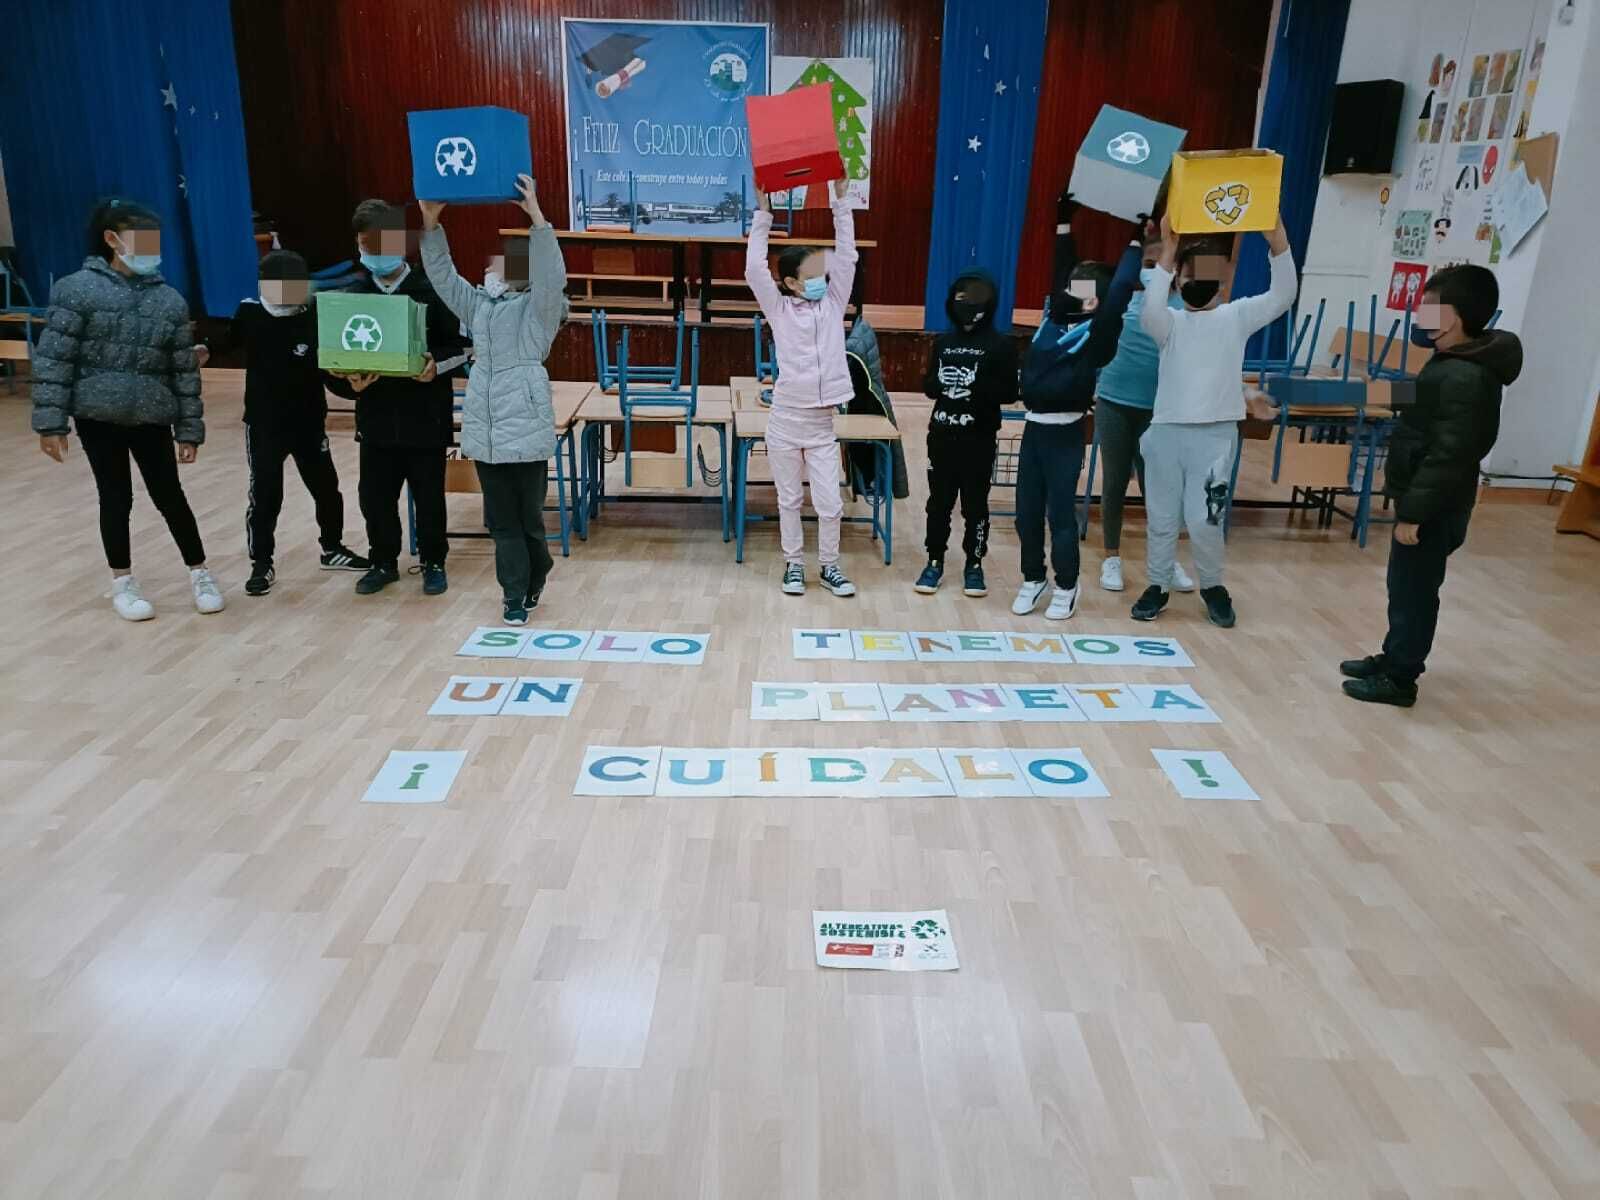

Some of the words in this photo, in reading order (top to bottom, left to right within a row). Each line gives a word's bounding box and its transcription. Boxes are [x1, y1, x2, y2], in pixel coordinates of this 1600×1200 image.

[476, 631, 702, 655] SOLO
[800, 632, 1177, 657] TENEMOS
[449, 682, 573, 704] UN
[760, 687, 1206, 713] PLANETA
[588, 751, 1089, 784] CUÍDALO
